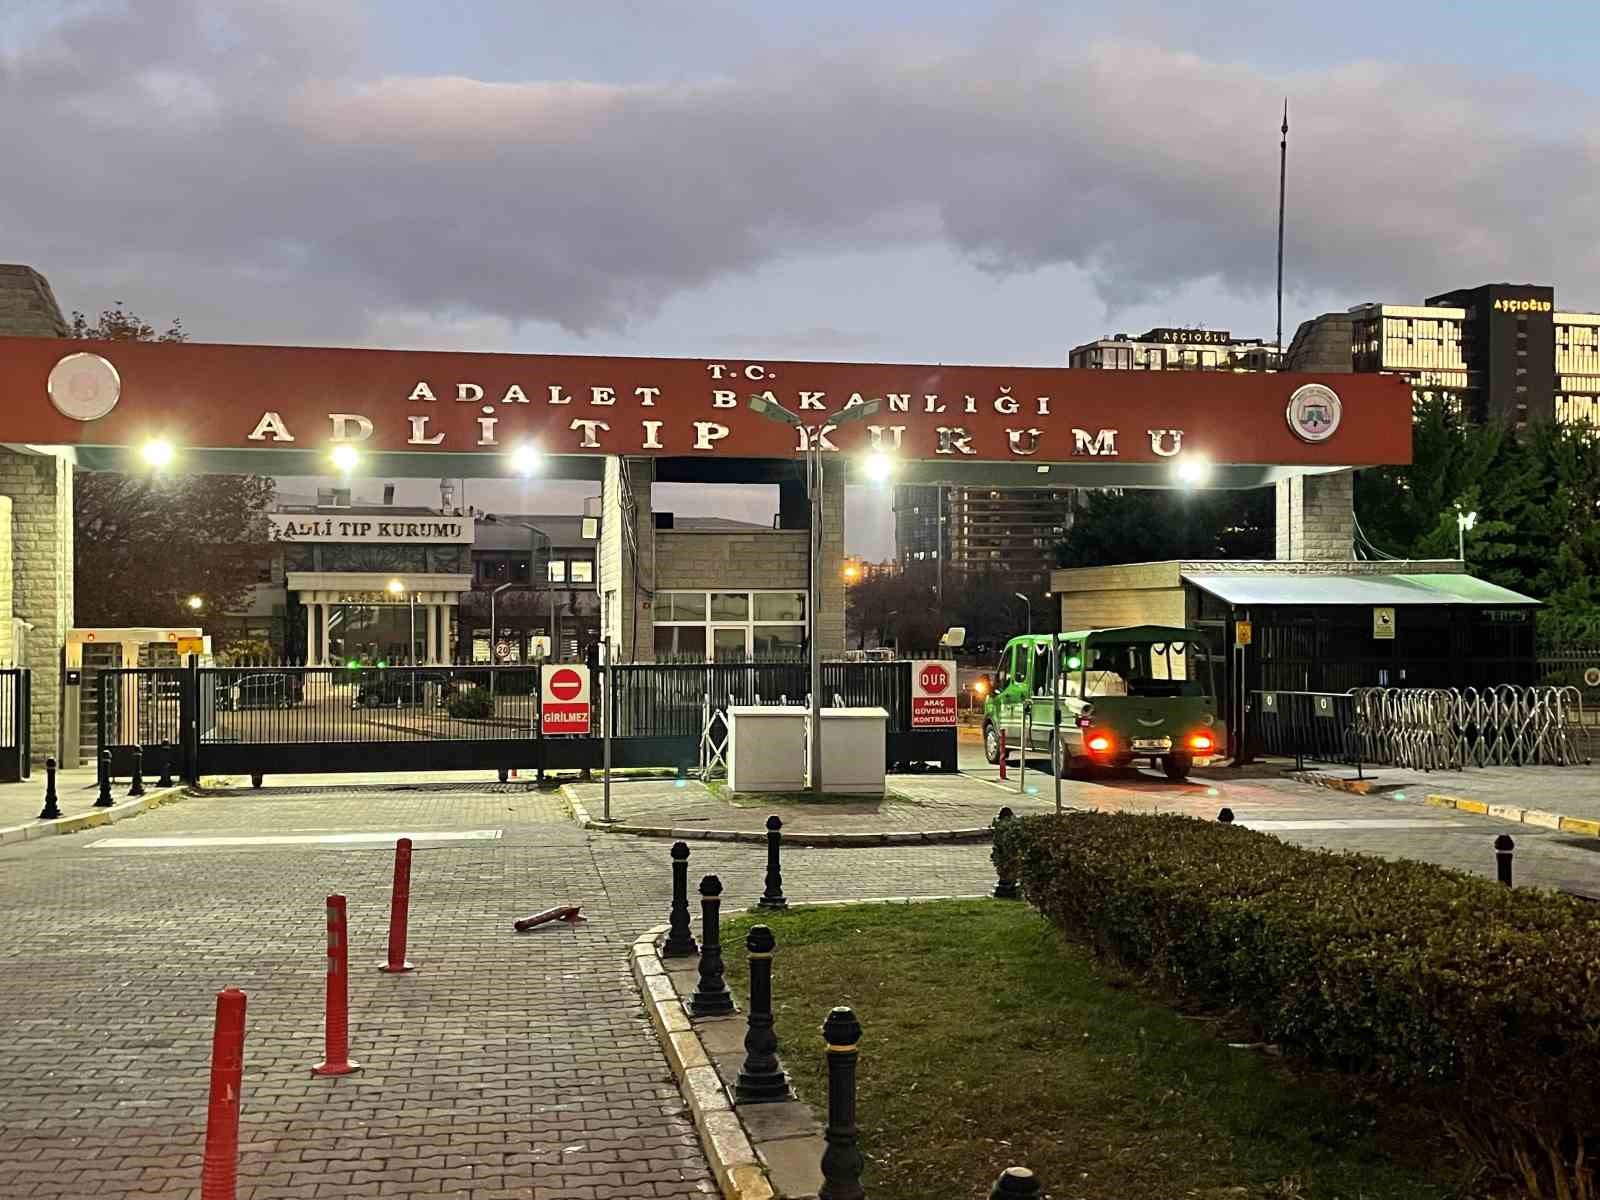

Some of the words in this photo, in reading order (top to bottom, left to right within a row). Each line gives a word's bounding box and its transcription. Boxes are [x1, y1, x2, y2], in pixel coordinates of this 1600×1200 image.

[1493, 298, 1551, 312] AŞÇIOĞLU
[1163, 332, 1226, 343] AŞÇIOĞLU
[707, 364, 776, 380] T.C.
[408, 381, 661, 406] ADALET
[248, 405, 499, 446] ADLİ
[570, 418, 730, 450] TIP
[795, 424, 1185, 457] KURUMU
[339, 522, 372, 537] TIP
[377, 522, 462, 538] KURUMU
[922, 673, 947, 686] DUR
